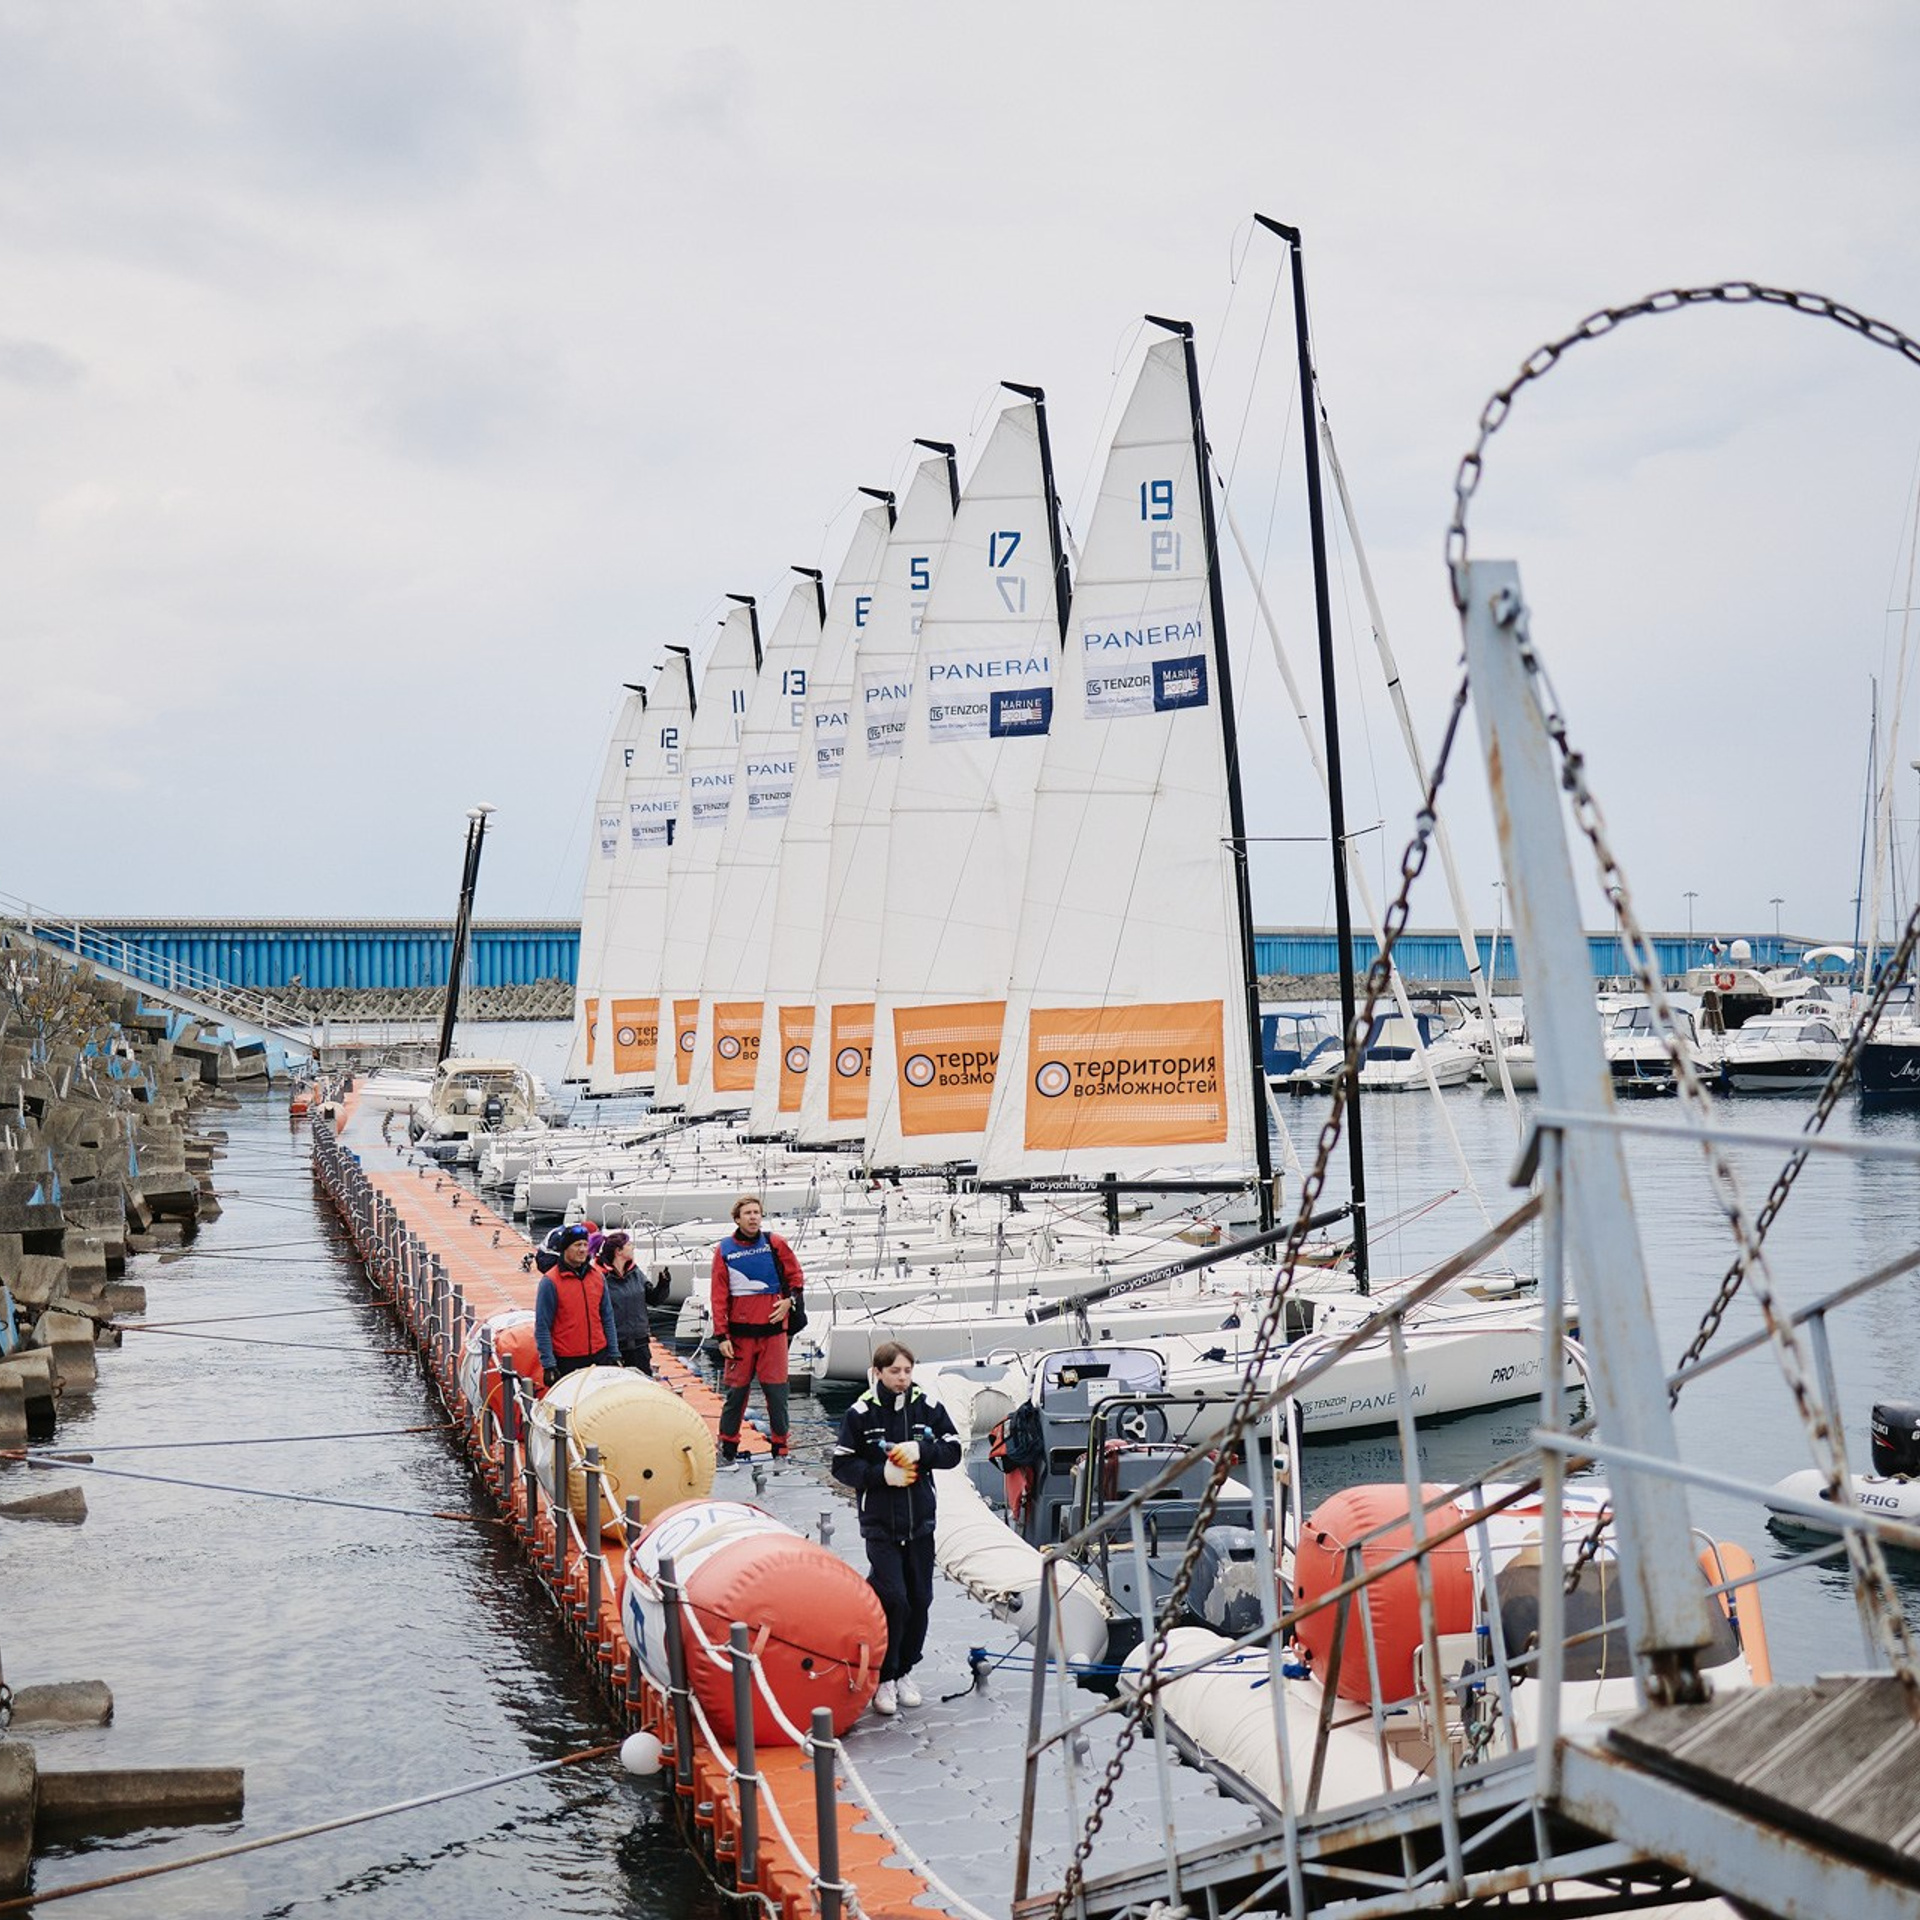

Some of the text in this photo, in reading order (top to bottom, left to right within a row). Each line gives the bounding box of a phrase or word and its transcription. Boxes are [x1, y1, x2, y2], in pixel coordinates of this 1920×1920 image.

[1140, 480, 1173, 520] 19
[988, 531, 1021, 568] 17
[911, 557, 930, 590] 5
[1084, 620, 1202, 651] PANERAI
[929, 656, 1049, 681] PANERAI
[782, 670, 806, 695] 13
[866, 683, 913, 703] PAN
[1103, 675, 1151, 690] TENZOR
[732, 690, 746, 713] 11
[944, 703, 988, 716] TENZOR
[1000, 698, 1043, 710] MARINE
[660, 727, 678, 749] 12
[881, 722, 906, 735] TENZ
[1073, 1055, 1216, 1082] территория
[1073, 1076, 1218, 1097] возможностей
[899, 1165, 958, 1177] pro-yachting.ru
[1030, 1181, 1098, 1192] pro-yachting.ru
[726, 1245, 772, 1260] PROYACHT
[1108, 1262, 1185, 1298] pro-yachting.ru
[1314, 1384, 1427, 1413] TENZOR PANEAI
[1856, 1492, 1900, 1509] BRIG
